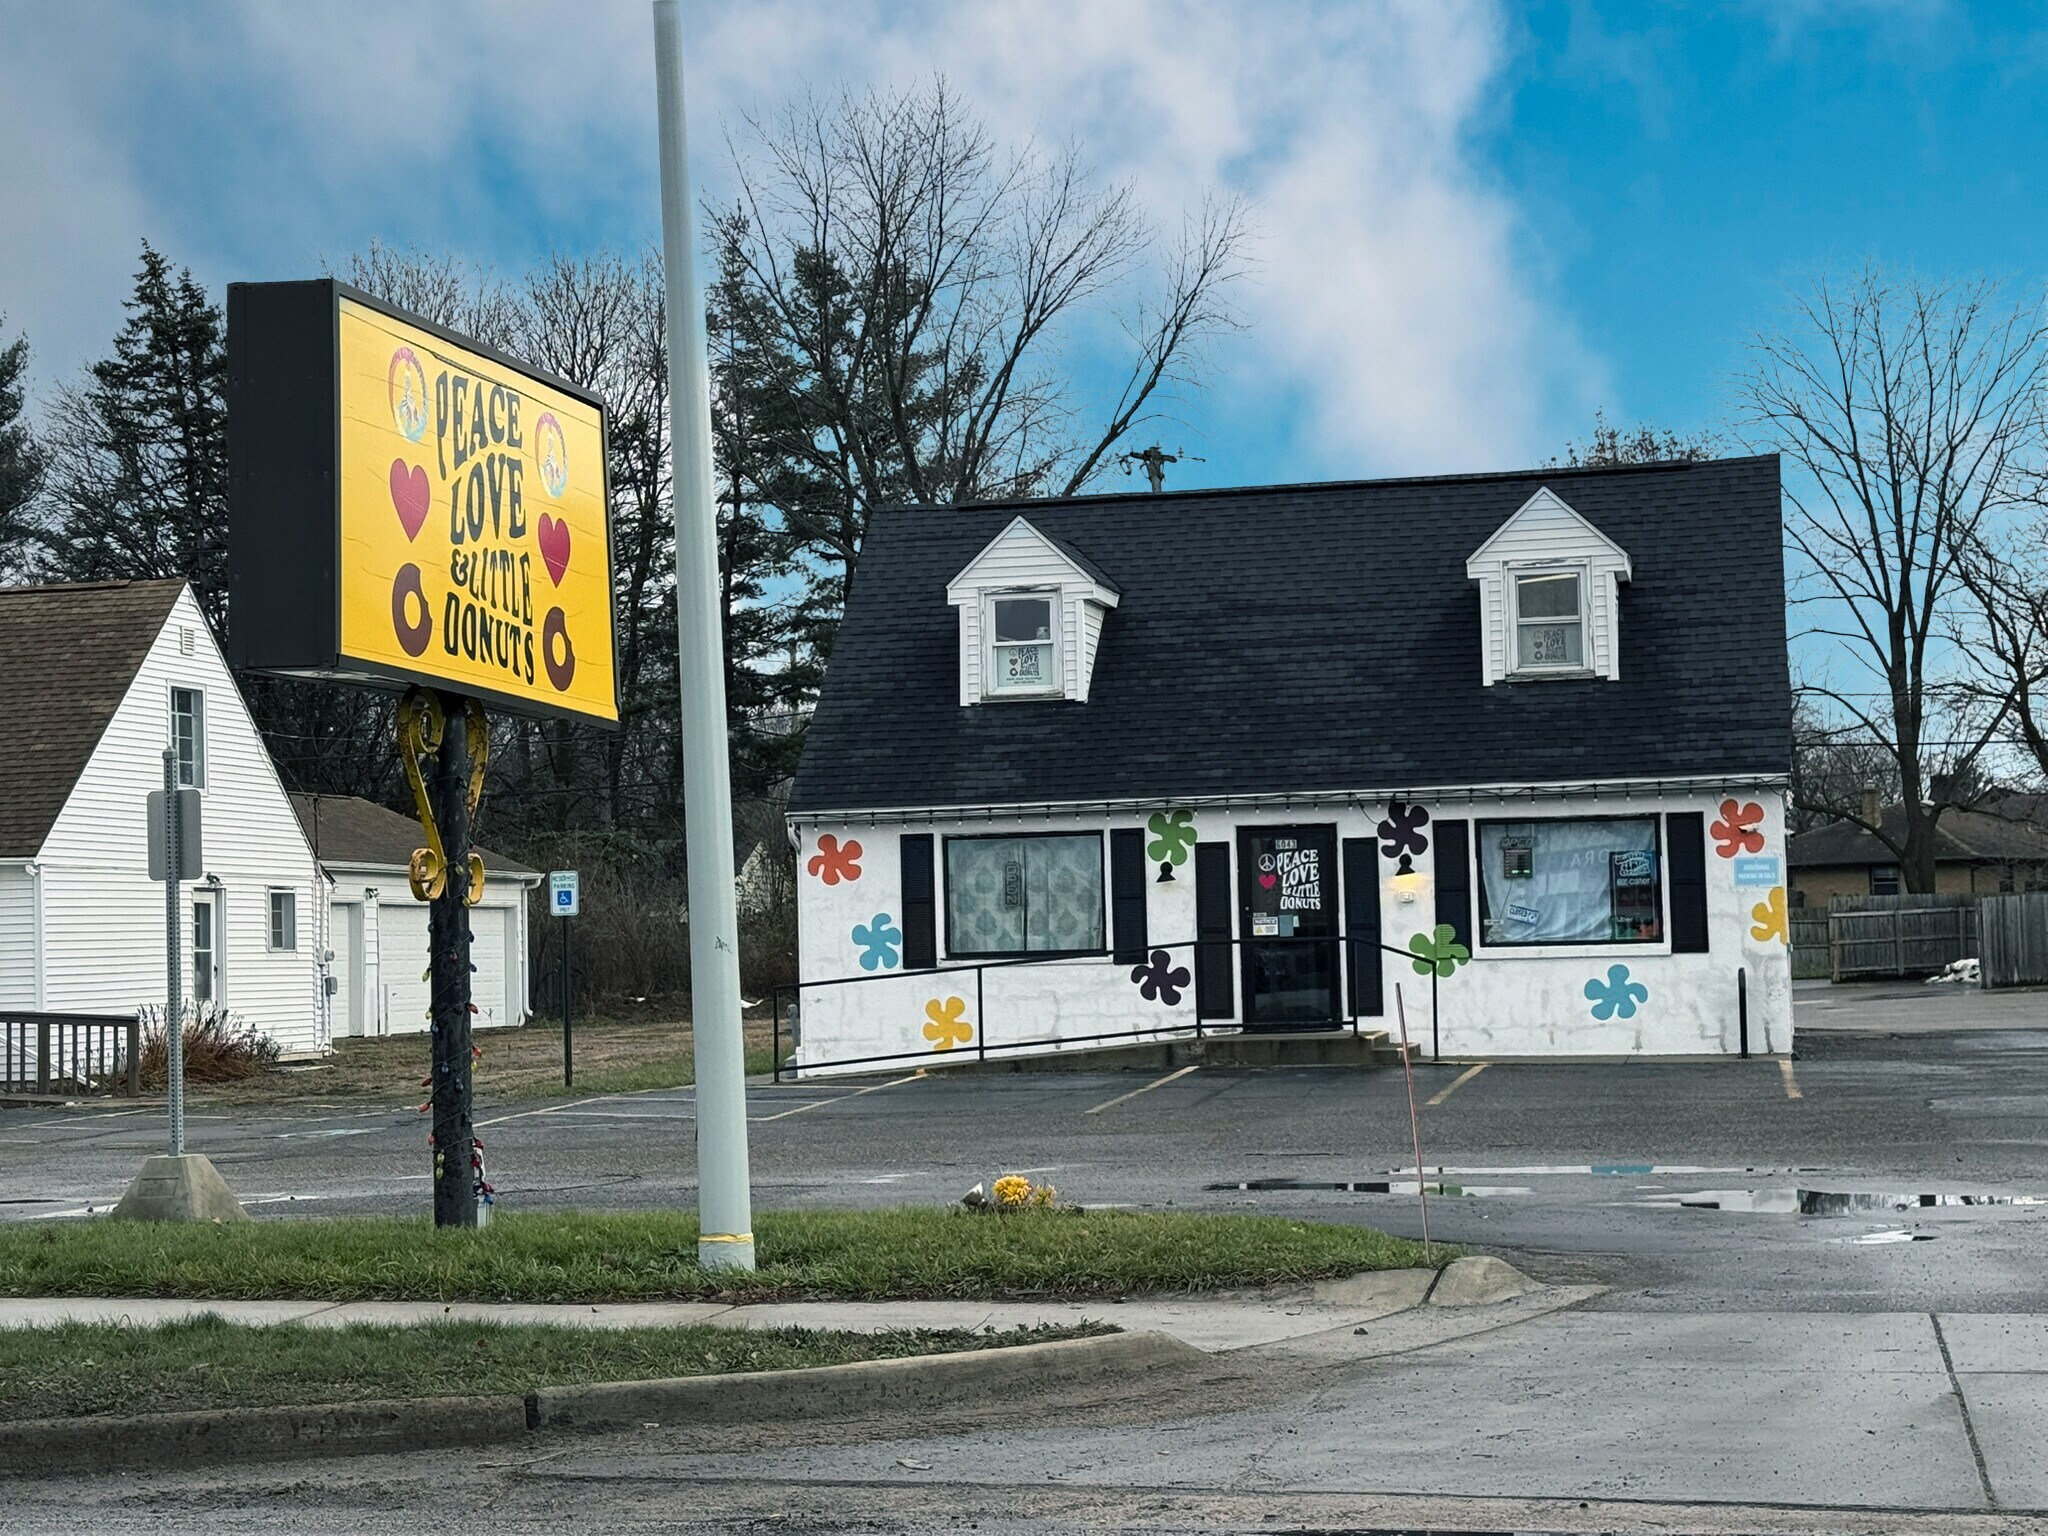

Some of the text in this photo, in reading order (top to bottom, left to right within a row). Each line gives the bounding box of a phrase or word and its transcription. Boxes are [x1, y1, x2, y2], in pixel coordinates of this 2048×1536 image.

[435, 370, 523, 481] PEACE
[450, 452, 526, 546] LOVE
[443, 591, 534, 686] DONUTS
[1021, 653, 1039, 668] LOVE
[1277, 849, 1319, 876] PEACE
[1282, 863, 1320, 888] LOVE
[1292, 881, 1320, 897] LITTLE
[1280, 896, 1321, 910] DONUTS
